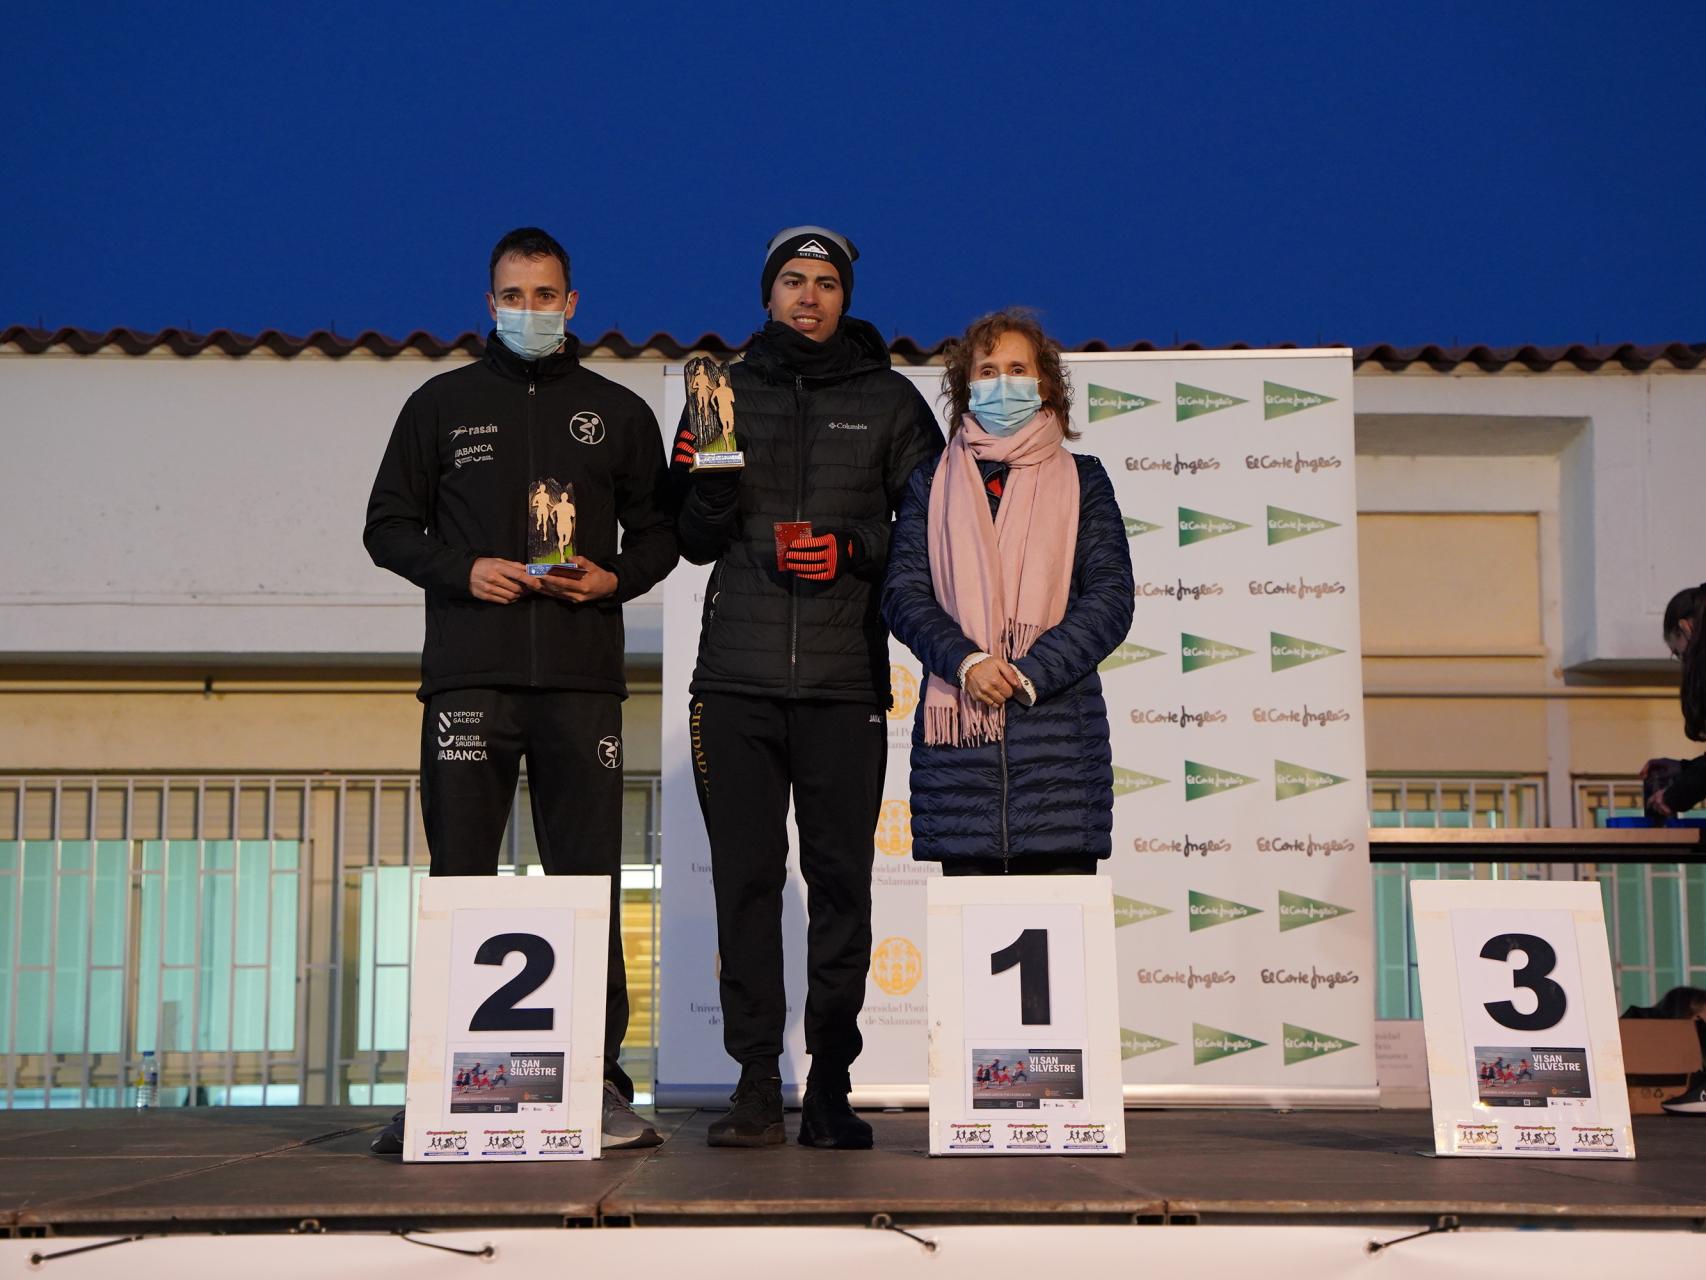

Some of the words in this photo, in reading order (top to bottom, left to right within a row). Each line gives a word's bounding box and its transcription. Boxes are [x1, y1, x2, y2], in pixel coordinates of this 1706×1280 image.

[1125, 457, 1139, 471] El
[1140, 457, 1172, 471] Corte
[1174, 453, 1220, 475] Inglés
[1245, 455, 1259, 469] El
[1260, 455, 1293, 469] Corte
[1294, 451, 1342, 474] Inglés
[1143, 582, 1175, 597] Corte
[1176, 578, 1224, 601] Inglés
[1249, 581, 1262, 595] El
[1264, 581, 1296, 595] Corte
[1298, 577, 1345, 599] Inglés
[1130, 709, 1145, 724] El
[1146, 709, 1178, 724] Corte
[1180, 705, 1227, 728] Inglés
[1252, 708, 1266, 722] El
[1268, 708, 1301, 722] Corte
[1302, 704, 1350, 727] Inglés
[691, 702, 708, 774] CIUDAD
[438, 750, 488, 760] ABANCA
[1134, 838, 1148, 852] El
[1149, 838, 1182, 852] Corte
[1183, 834, 1231, 857] Inglés
[1257, 837, 1271, 852] El
[1272, 837, 1305, 852] Corte
[1306, 833, 1355, 857] Inglés
[469, 932, 555, 1031] 2
[991, 929, 1050, 1025] 1
[1137, 969, 1152, 984] El
[1153, 969, 1186, 984] Corte
[1187, 965, 1235, 989] Inglés
[1261, 969, 1275, 984] El
[1276, 969, 1309, 984] Corte
[1311, 965, 1359, 989] Inglés
[1480, 933, 1567, 1031] 3
[511, 1059, 521, 1068] VI
[521, 1059, 540, 1068] SAN
[1029, 1056, 1039, 1064] VI
[1040, 1056, 1058, 1064] SAN
[1029, 1064, 1076, 1073] SILVESTRE
[1532, 1054, 1543, 1063] VI
[1544, 1055, 1562, 1063] SAN
[1534, 1062, 1581, 1071] SILVESTRE
[510, 1067, 557, 1076] SILVESTRE
